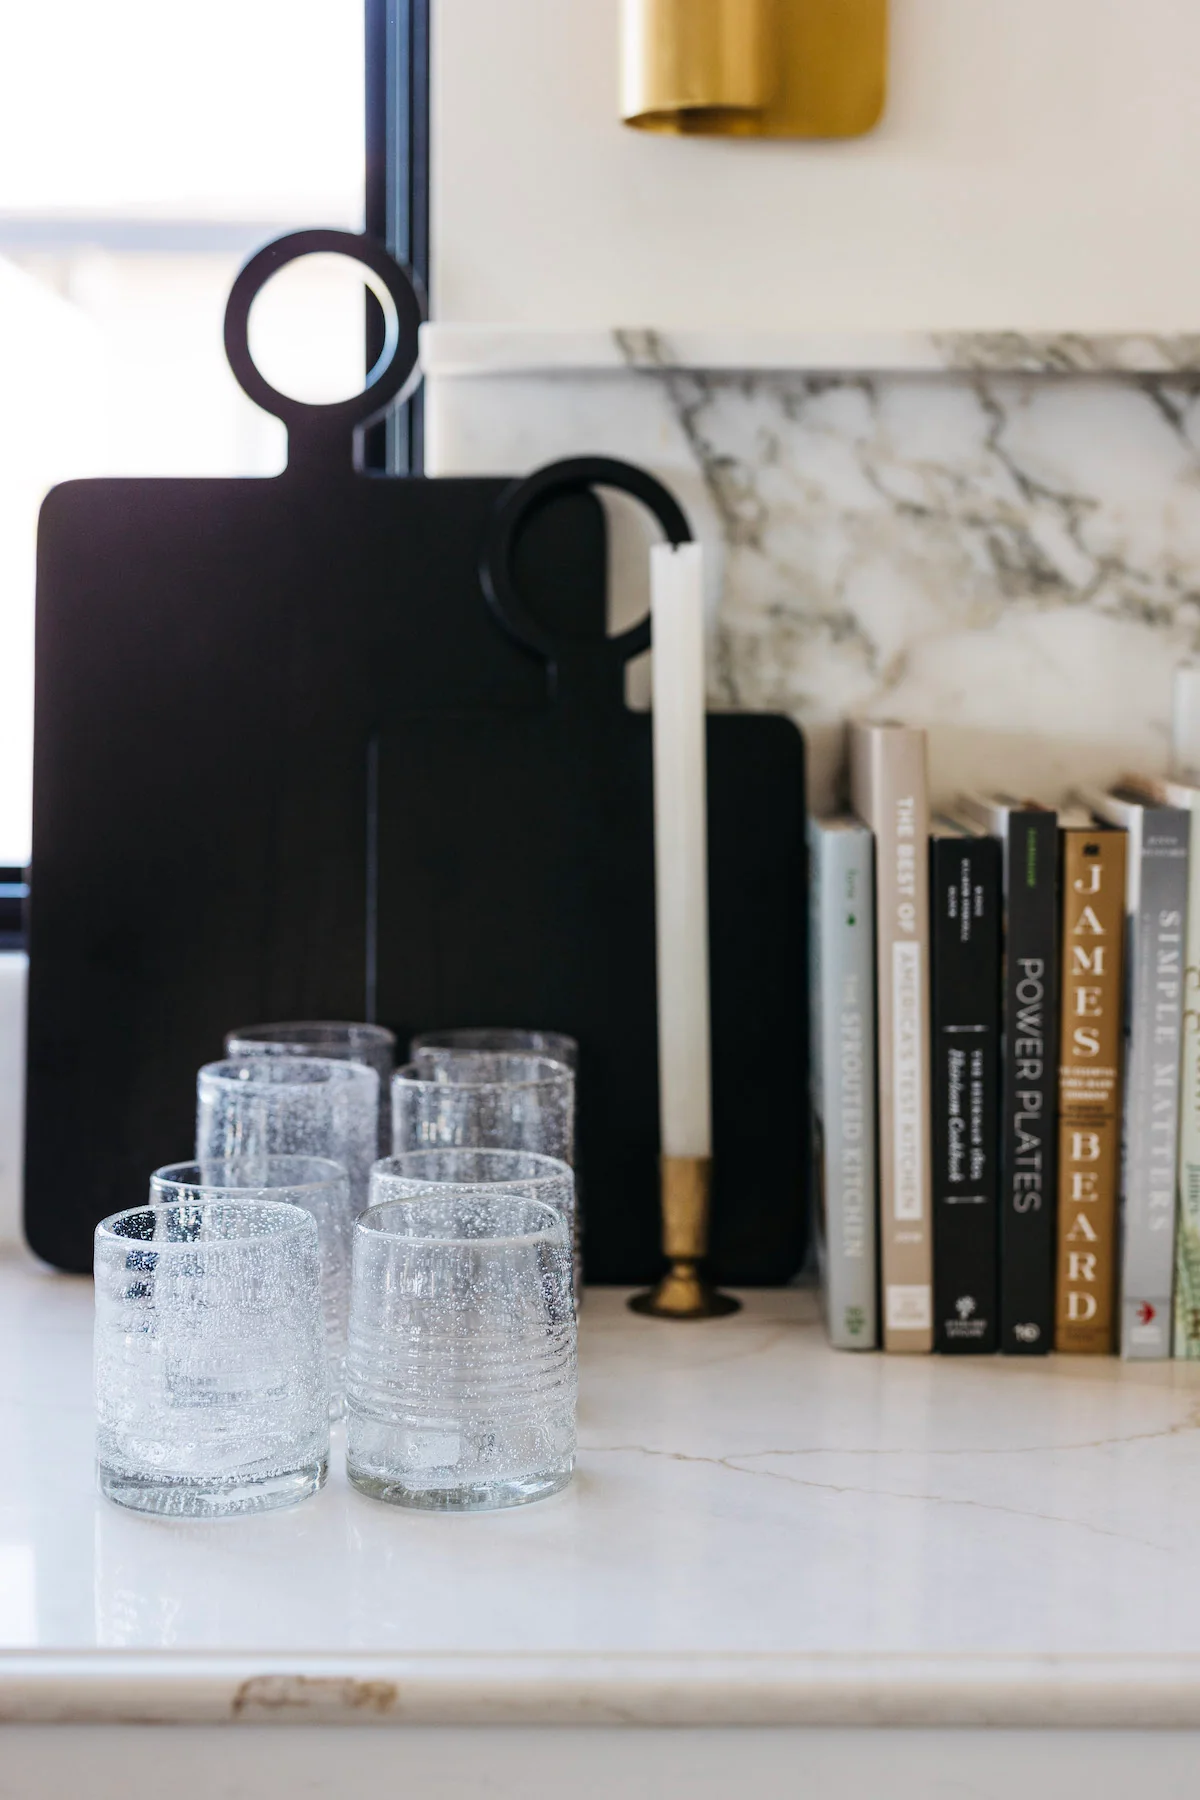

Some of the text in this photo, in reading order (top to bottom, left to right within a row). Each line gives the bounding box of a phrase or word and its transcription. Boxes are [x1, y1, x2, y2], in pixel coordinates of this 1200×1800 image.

[896, 794, 916, 934] THE BEST OF
[1071, 863, 1106, 1058] JAMES
[841, 1012, 864, 1139] SPROUTED
[1013, 958, 1044, 1214] POWER PLATES
[1148, 908, 1182, 1231] SIMPLE MATTERS
[841, 1147, 864, 1258] KITCHEN
[899, 1123, 917, 1211] KITCHEN
[1065, 1131, 1101, 1321] BEARD
